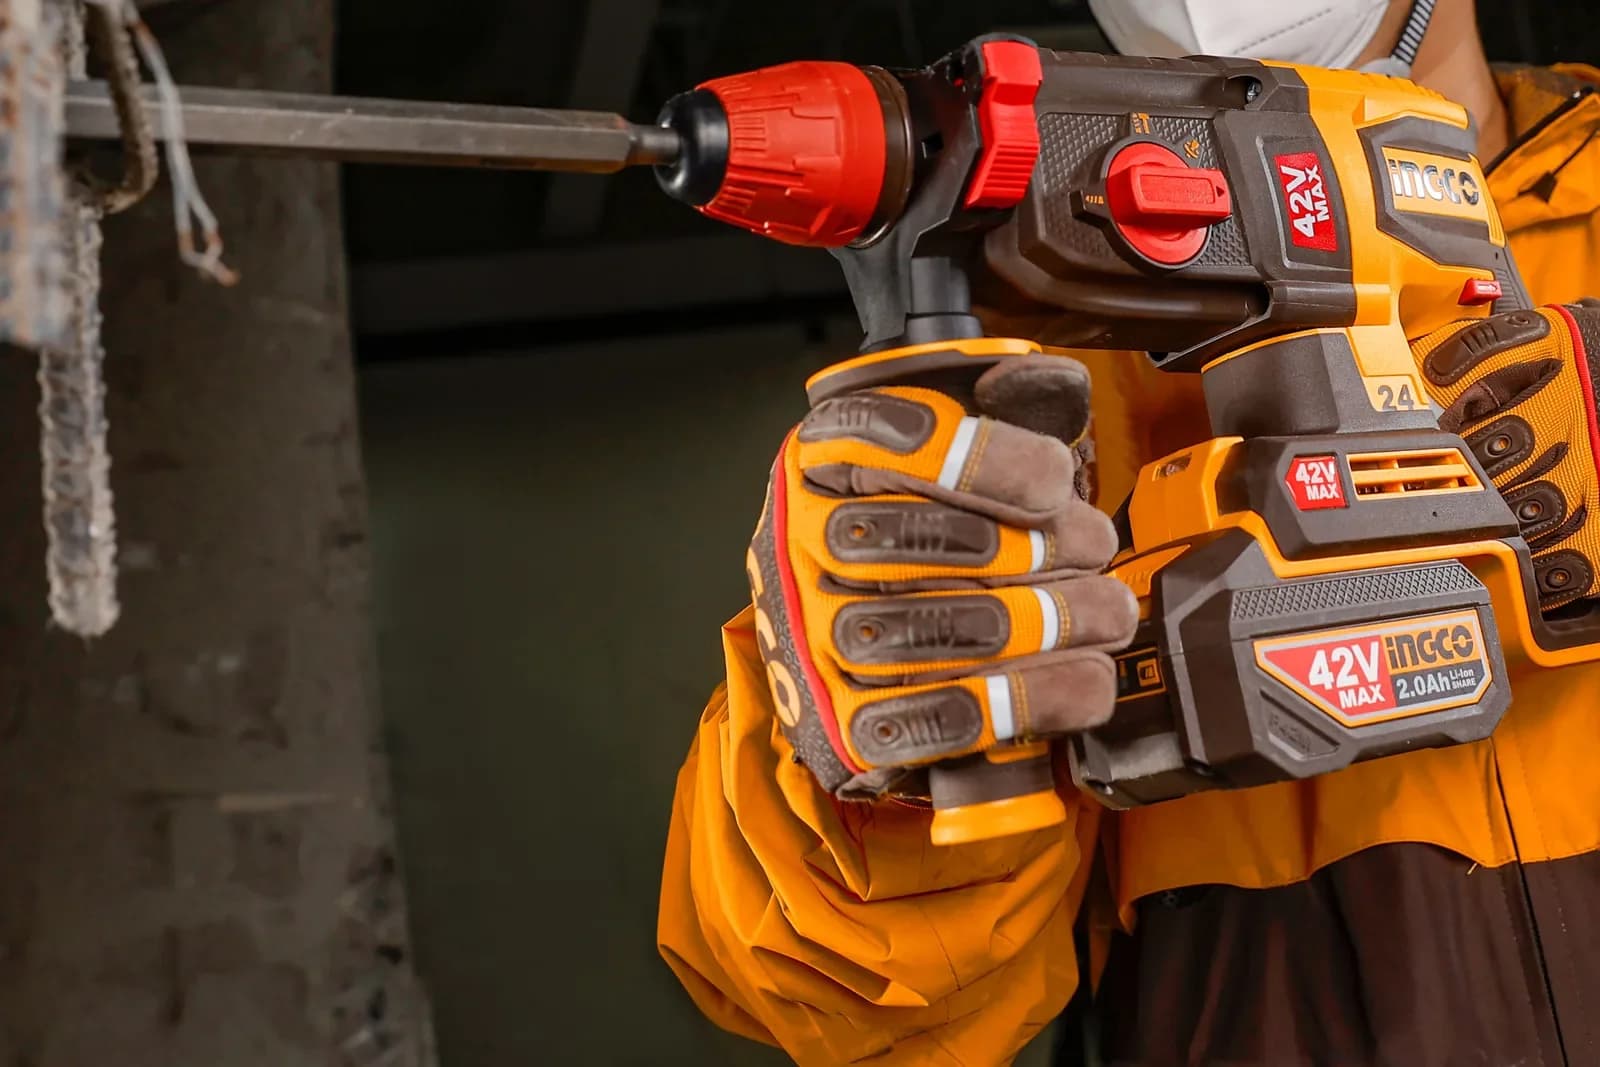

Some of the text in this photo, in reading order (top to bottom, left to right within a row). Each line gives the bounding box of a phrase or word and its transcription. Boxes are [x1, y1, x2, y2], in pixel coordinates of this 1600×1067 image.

[1280, 165, 1314, 238] 42V
[1303, 164, 1330, 223] MAX
[1377, 384, 1414, 410] 24
[1295, 461, 1335, 484] 42V
[1306, 483, 1340, 501] MAX
[1308, 641, 1380, 690] 42V
[1396, 672, 1451, 699] 2.0Ah
[1451, 677, 1477, 689] SHARE
[1339, 684, 1386, 709] MAX
